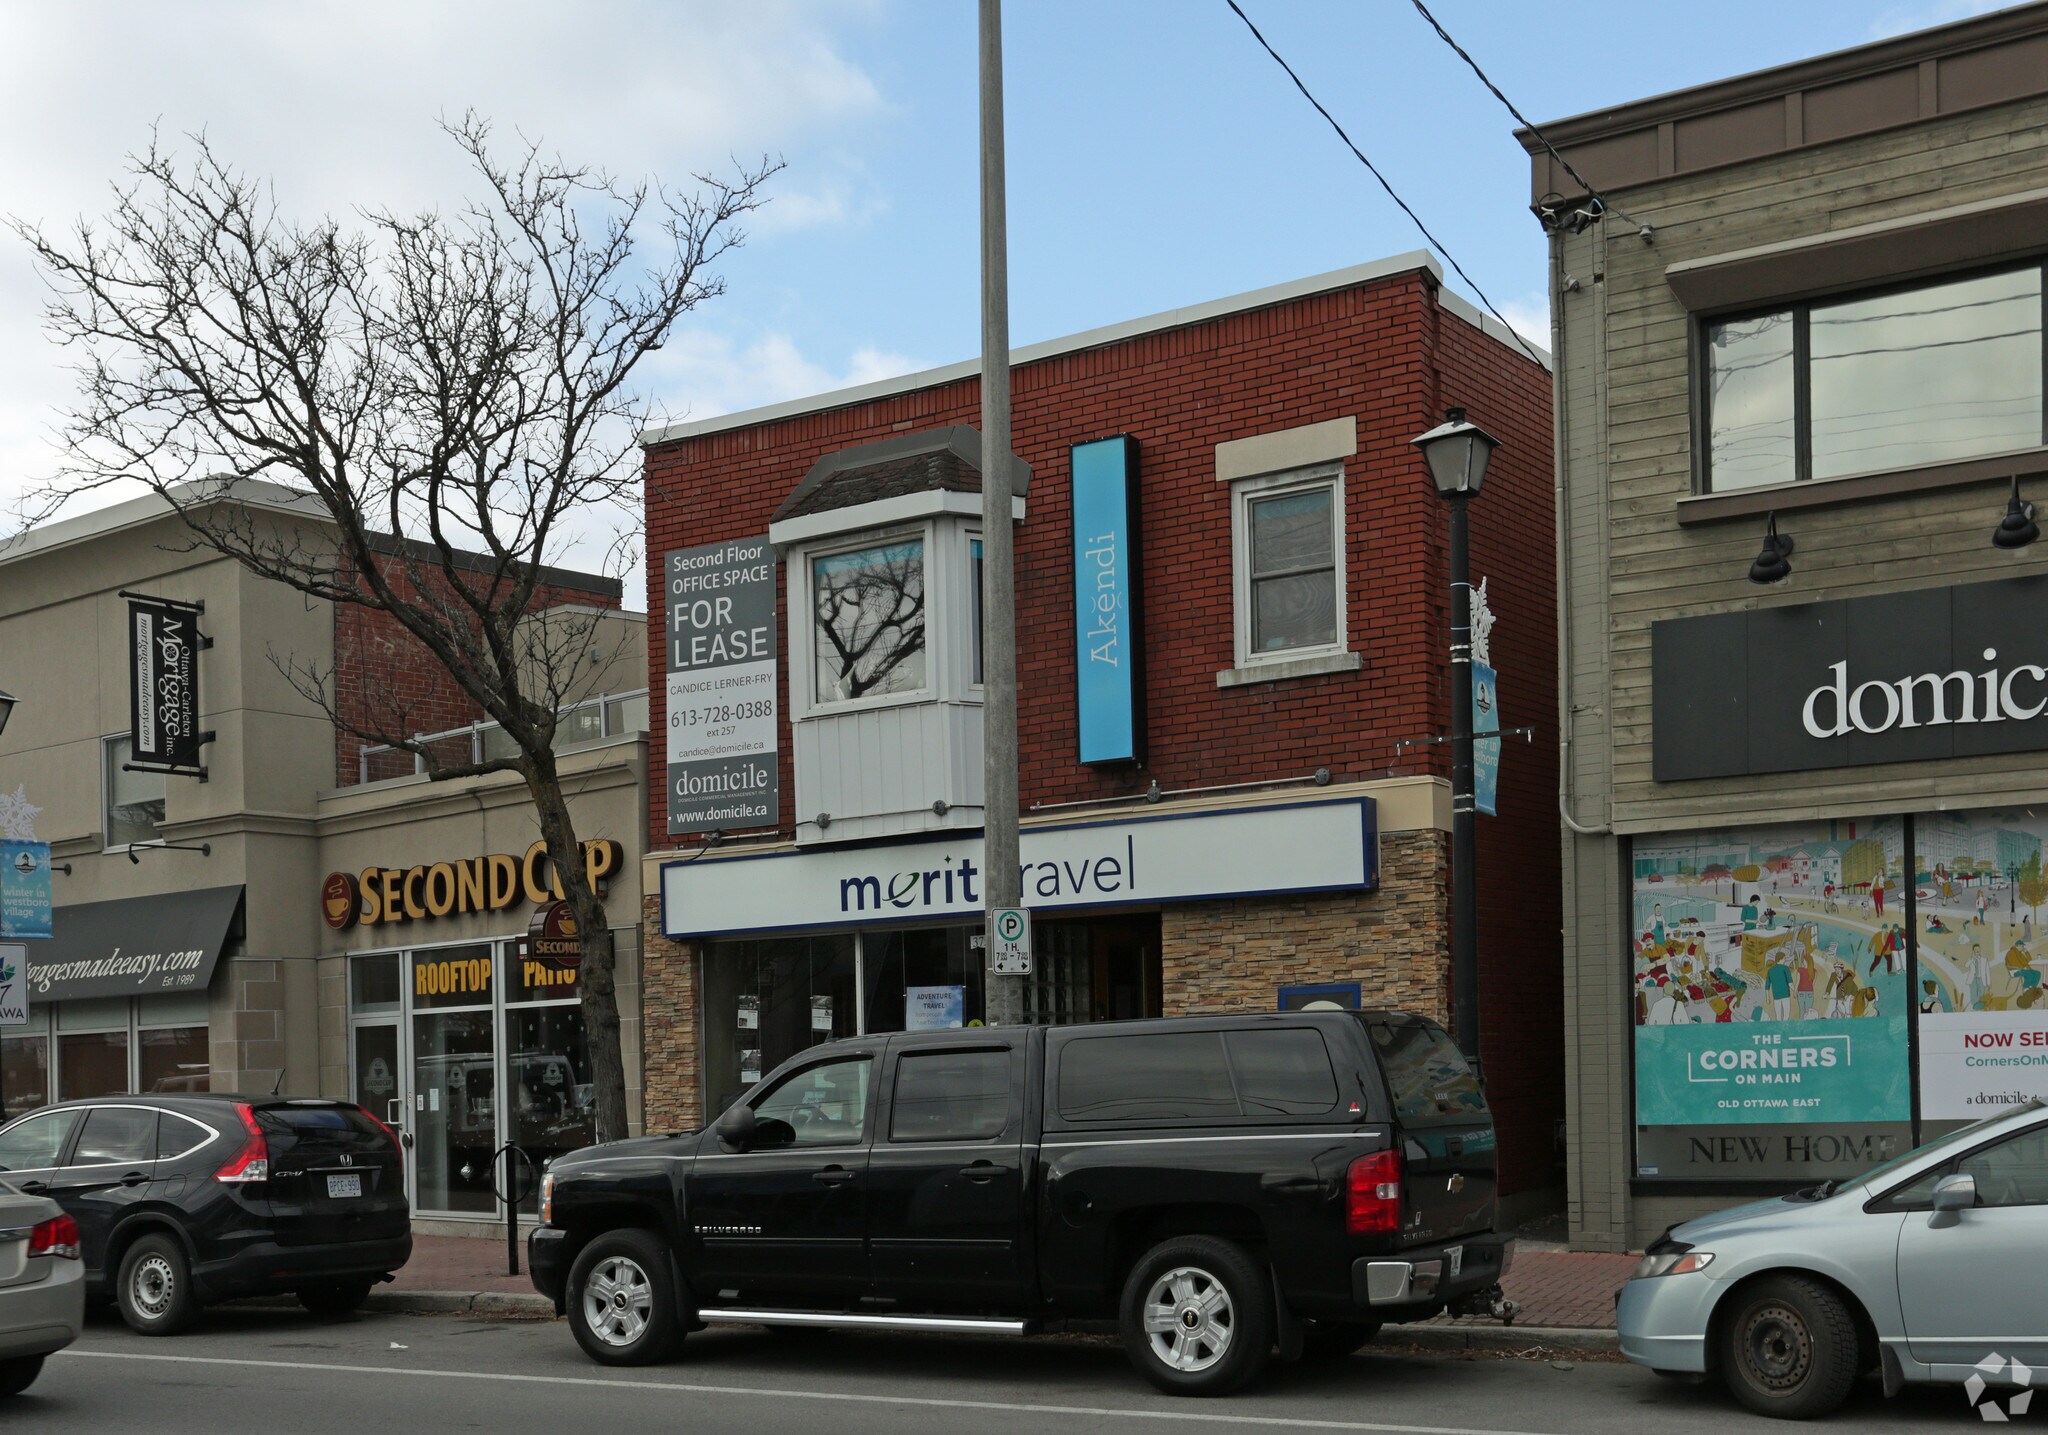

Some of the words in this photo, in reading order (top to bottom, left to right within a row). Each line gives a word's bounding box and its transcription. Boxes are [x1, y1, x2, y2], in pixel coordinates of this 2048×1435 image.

[674, 549, 724, 572] Second
[727, 546, 763, 563] Floor
[672, 573, 720, 594] OFFICE
[723, 565, 768, 587] SPACE
[674, 597, 733, 632] FOR
[674, 627, 768, 667] LEASE
[137, 618, 152, 746] mortgagesmadeeasy.com
[181, 646, 192, 737] Ottawa-Carleton
[670, 681, 712, 695] CANDICE
[714, 673, 773, 690] LERNER-FRY
[1802, 647, 2048, 739] domic
[671, 700, 773, 728] 613-728-0388
[706, 728, 719, 737] ext
[721, 726, 736, 736] 257
[166, 737, 174, 757] inc.
[678, 741, 765, 758] candice@domicile.ca
[676, 763, 768, 796] domicile
[676, 804, 767, 823] www.domicile.ca
[840, 854, 979, 912] merit
[1020, 834, 1135, 898] ravel
[3, 888, 34, 898] winter
[36, 887, 46, 898] in
[358, 854, 518, 926] SECOND
[3, 897, 49, 907] westboro
[3, 907, 34, 918] village
[1006, 918, 1017, 934] P
[1011, 943, 1020, 952] H.
[175, 974, 195, 985] 1989
[416, 958, 492, 995] ROOFTOP
[916, 992, 952, 1000] ADVENTURE
[1752, 1034, 1782, 1045] THE
[1965, 1032, 2014, 1048] NOW
[2019, 1031, 2048, 1047] SE
[1700, 1047, 1837, 1070] CORNERS
[1735, 1074, 1757, 1084] ON
[1762, 1073, 1801, 1084] MAIN
[1717, 1100, 1740, 1108] OLD
[1743, 1099, 1789, 1108] OTTAWA
[1792, 1098, 1821, 1107] EAST
[1966, 1096, 1973, 1104] a
[1975, 1090, 2028, 1104] domicile
[1688, 1136, 1773, 1163] NEW
